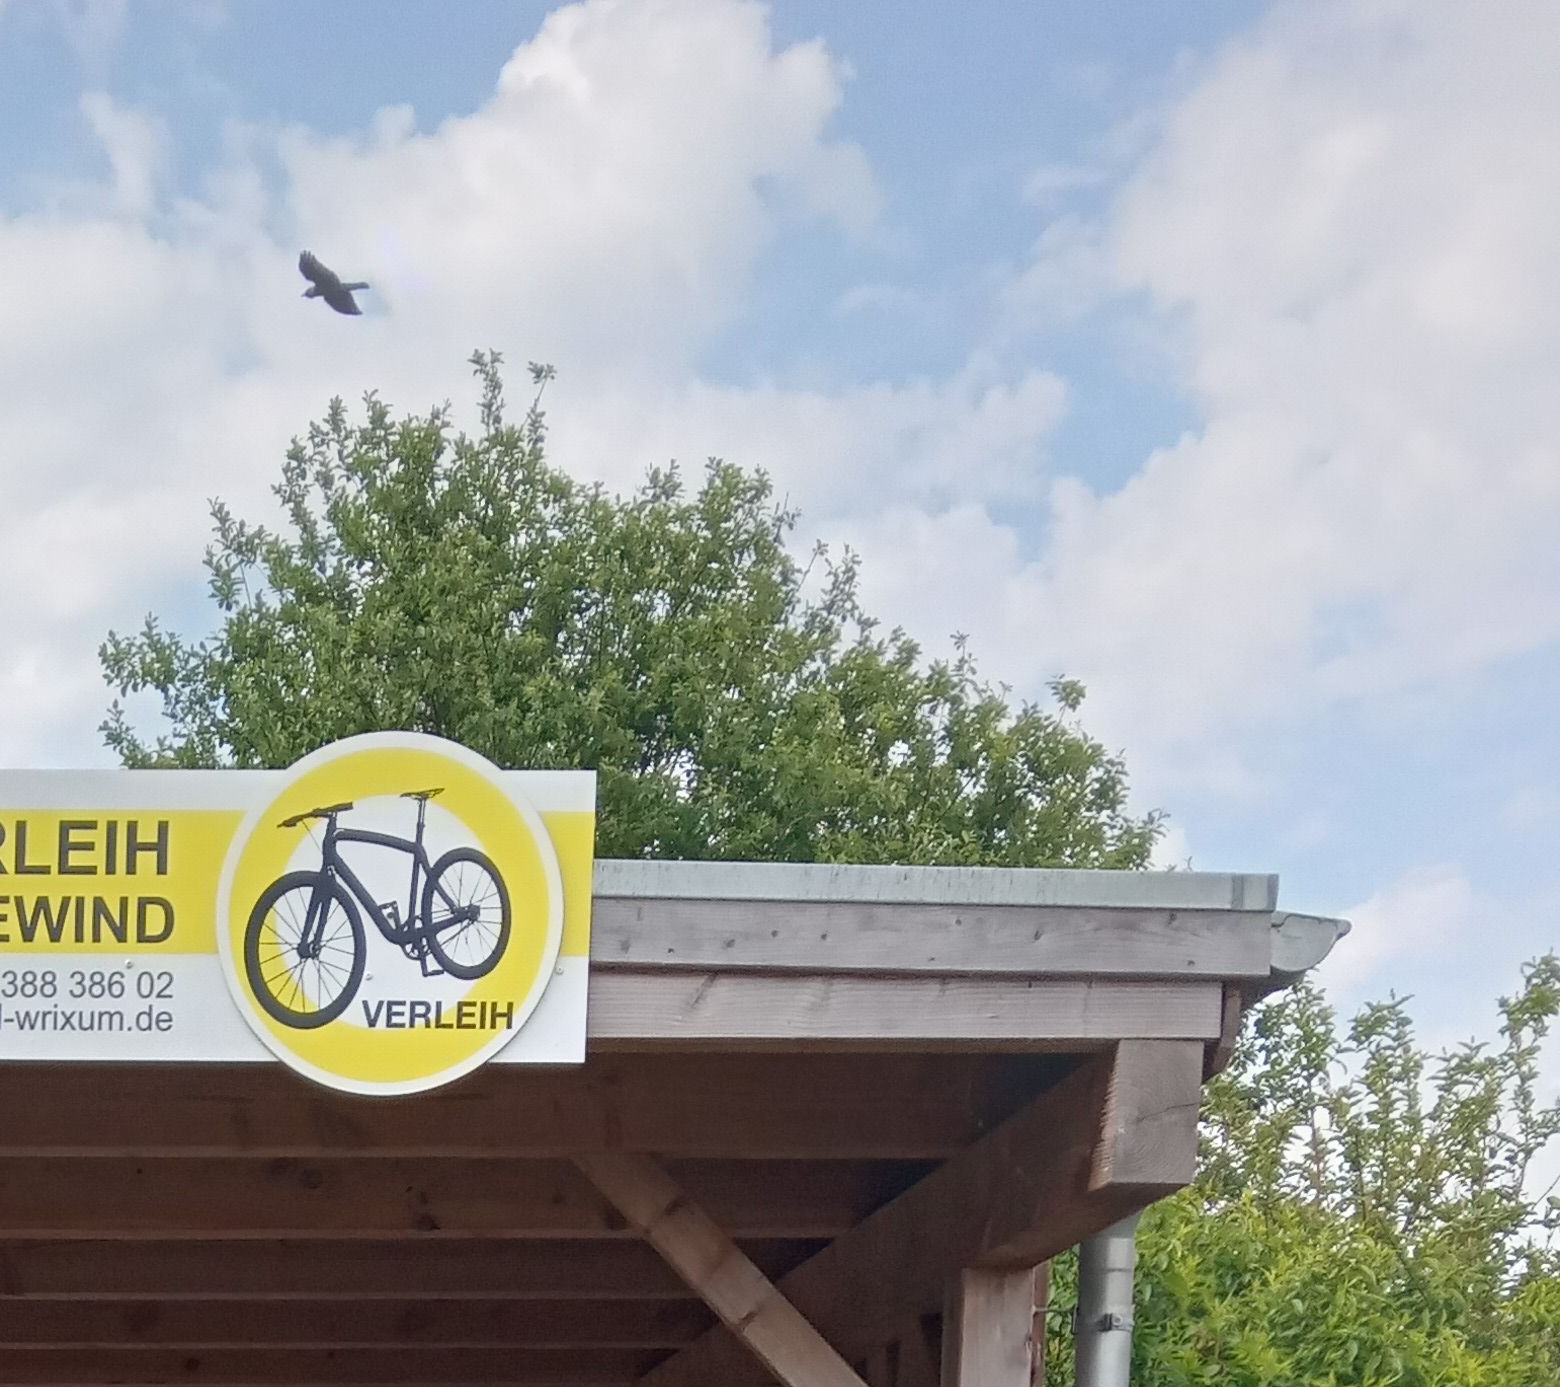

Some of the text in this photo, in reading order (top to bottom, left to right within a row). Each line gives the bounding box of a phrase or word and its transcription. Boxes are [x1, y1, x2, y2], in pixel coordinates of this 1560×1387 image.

[1, 969, 58, 999] 388
[68, 970, 126, 999] 386
[136, 971, 175, 1000] 02
[361, 1000, 515, 1030] VERLEIH
